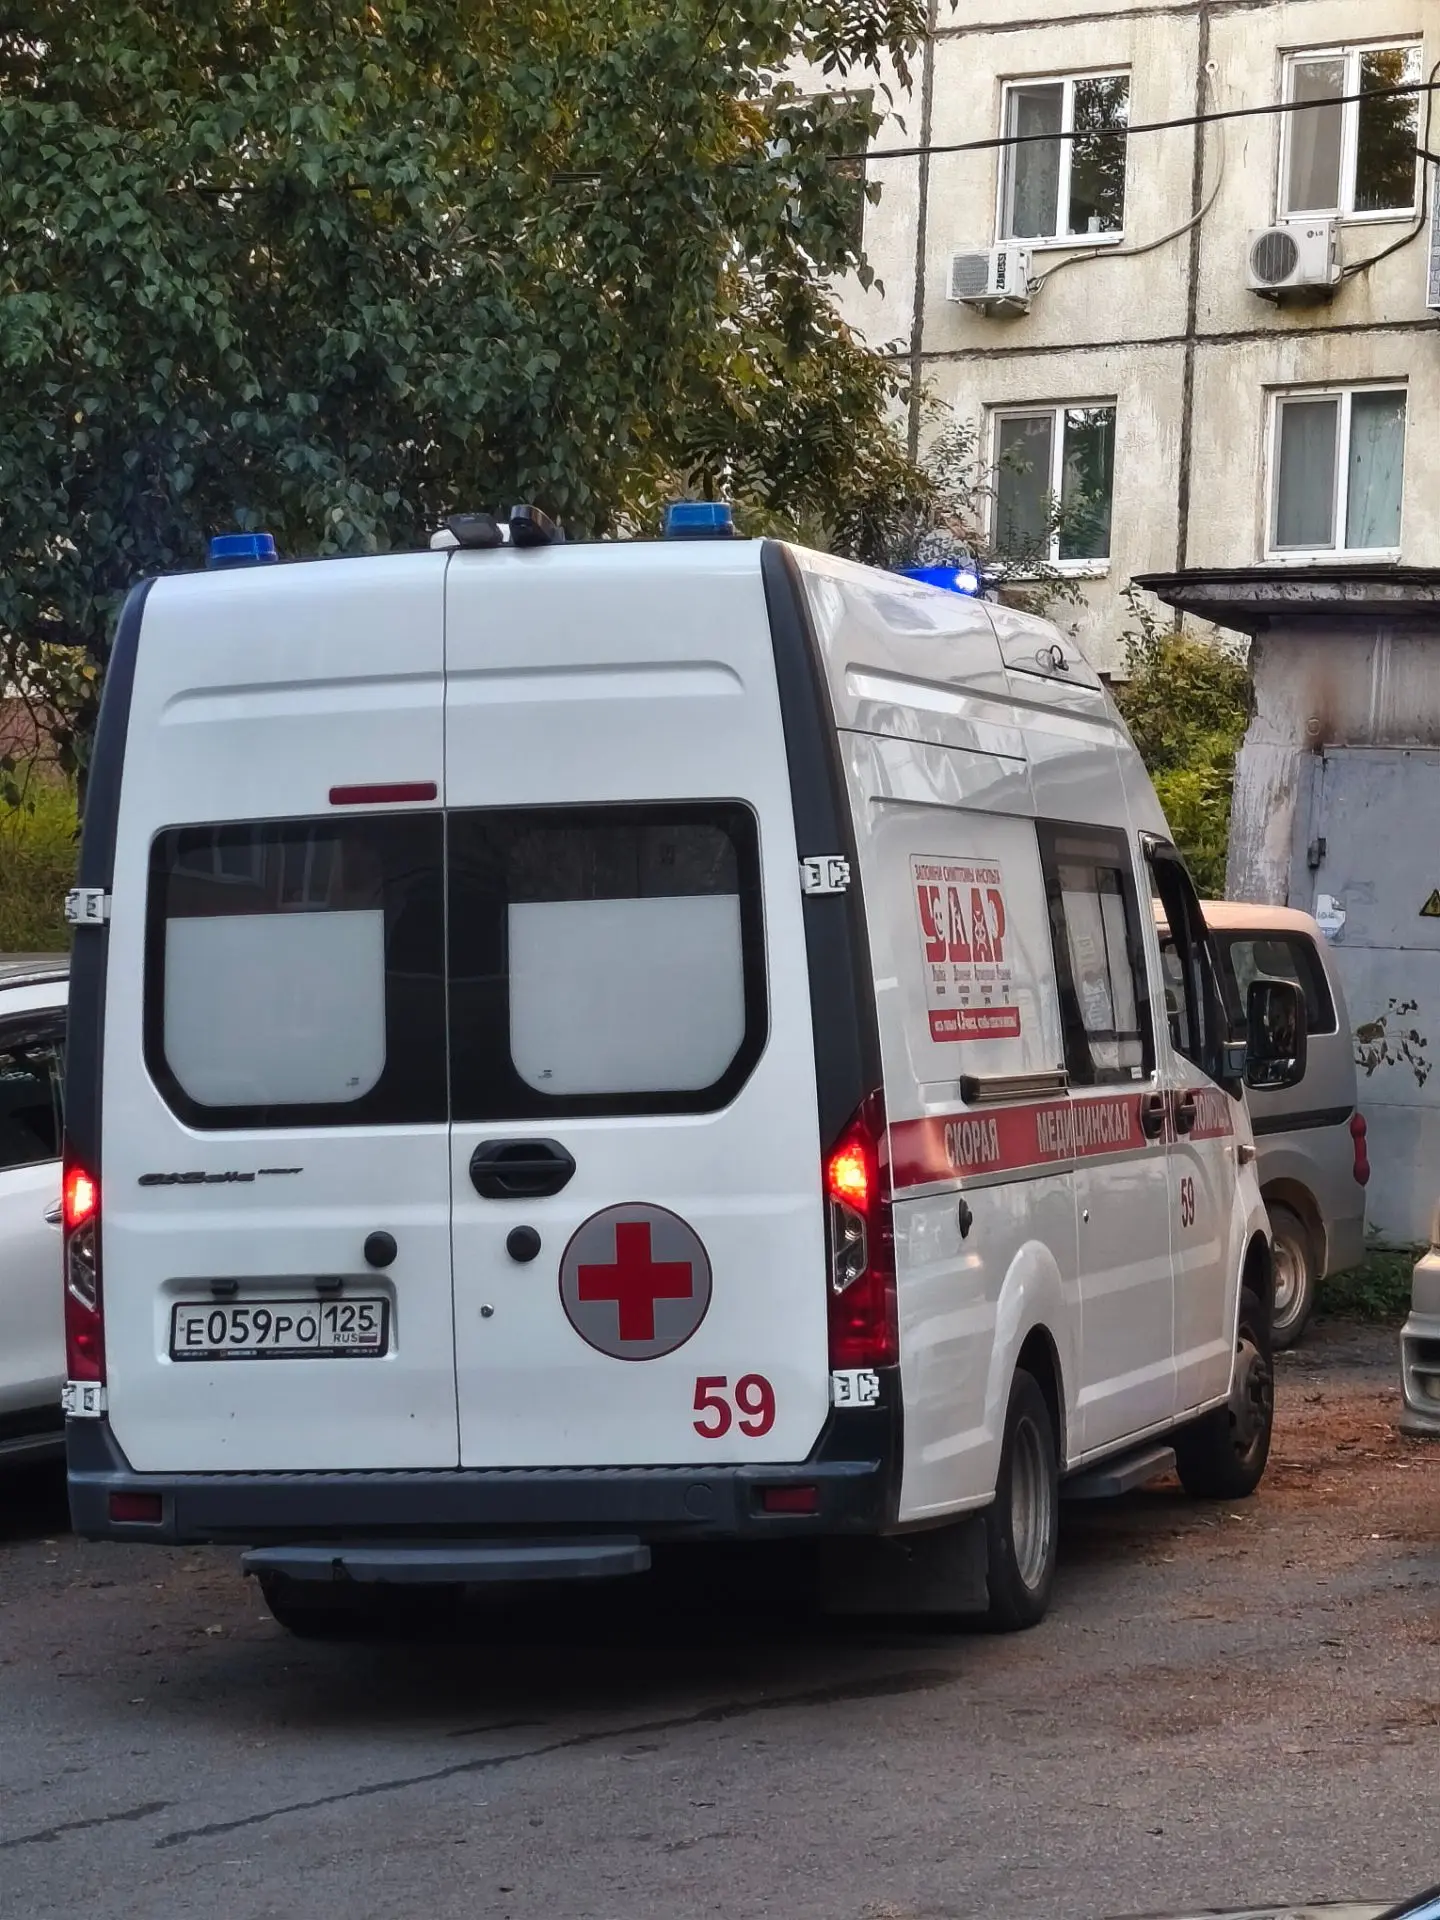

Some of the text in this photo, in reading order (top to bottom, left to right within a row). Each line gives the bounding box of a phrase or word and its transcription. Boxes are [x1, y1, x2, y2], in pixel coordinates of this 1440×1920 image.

[944, 1118, 1000, 1168] СКОРАЯ
[1036, 1102, 1131, 1159] МЕДИЦИНСКАЯ
[1181, 1176, 1195, 1228] 59
[324, 1304, 374, 1332] 125
[333, 1332, 359, 1343] RUS
[692, 1373, 777, 1439] 59
